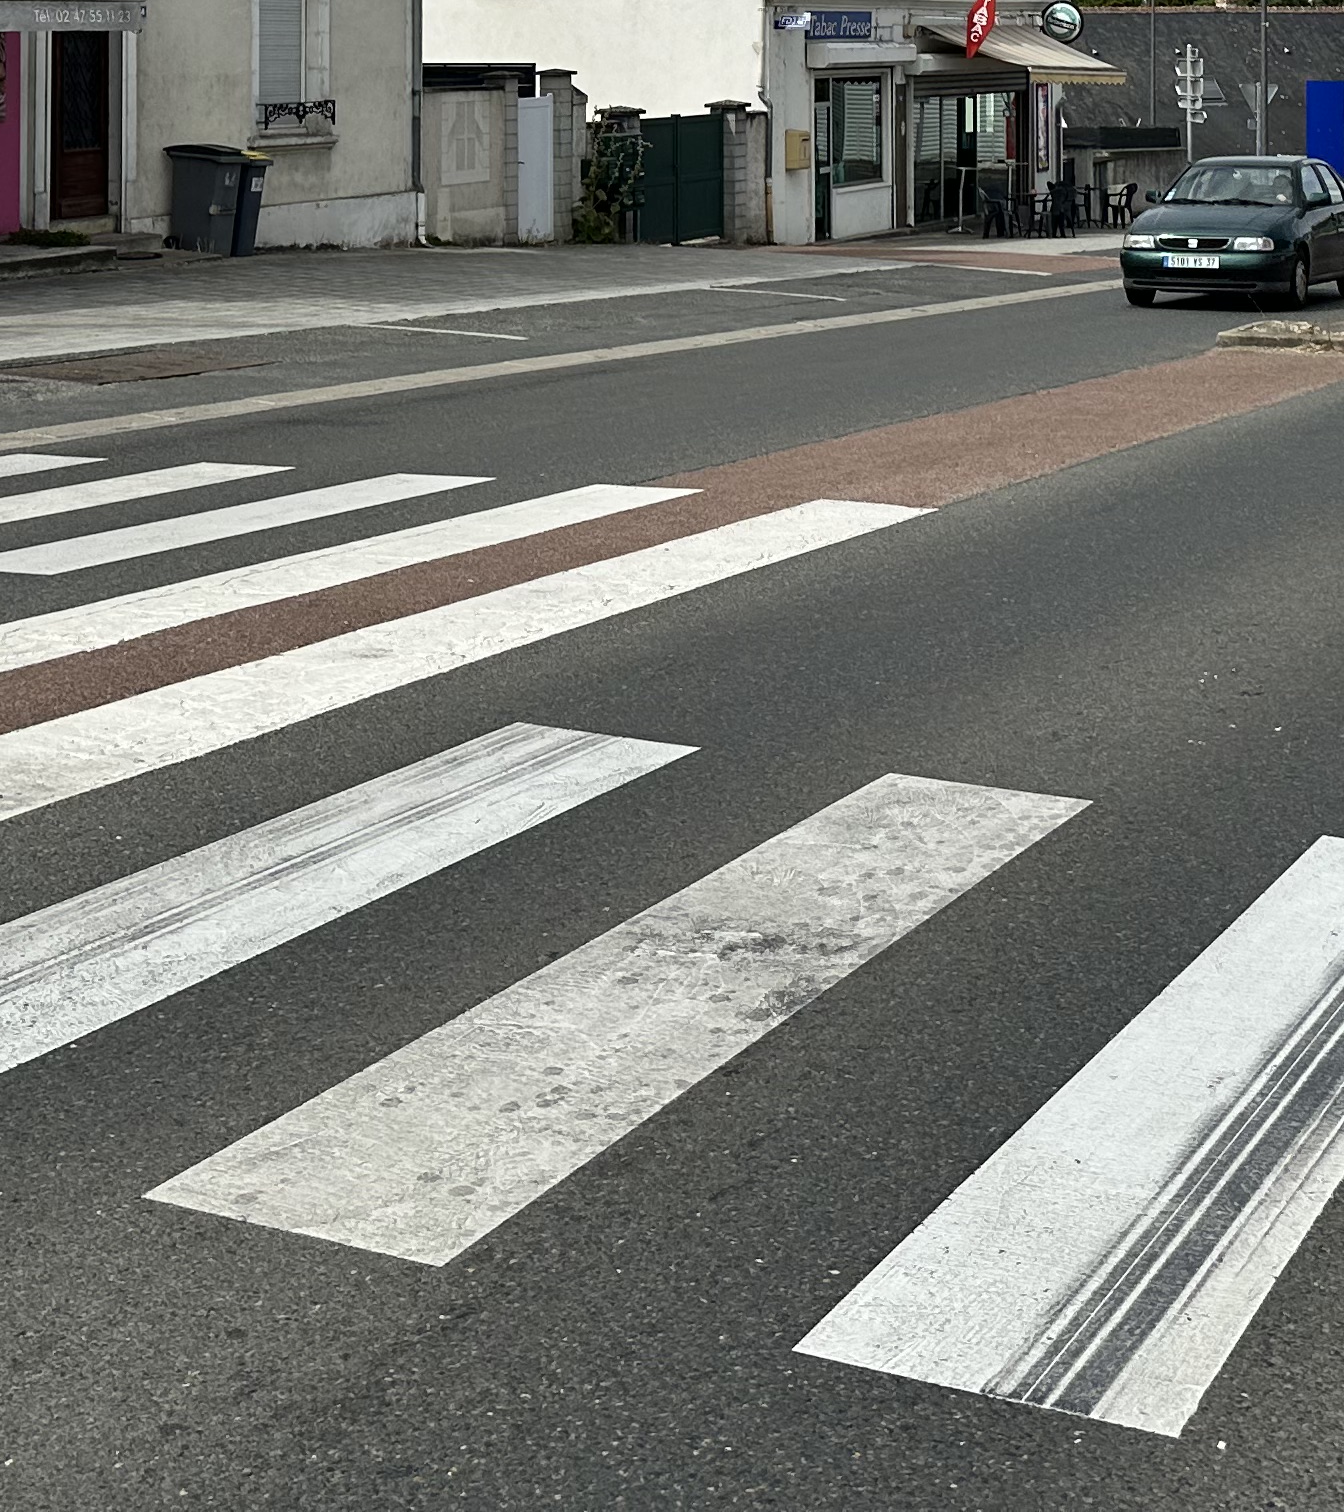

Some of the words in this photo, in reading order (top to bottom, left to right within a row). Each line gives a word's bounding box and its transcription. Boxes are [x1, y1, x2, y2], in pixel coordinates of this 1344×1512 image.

[56, 10, 70, 22] 02
[74, 9, 85, 22] 47
[89, 10, 102, 22] 55
[810, 14, 837, 36] Tabac
[840, 15, 871, 35] Presse
